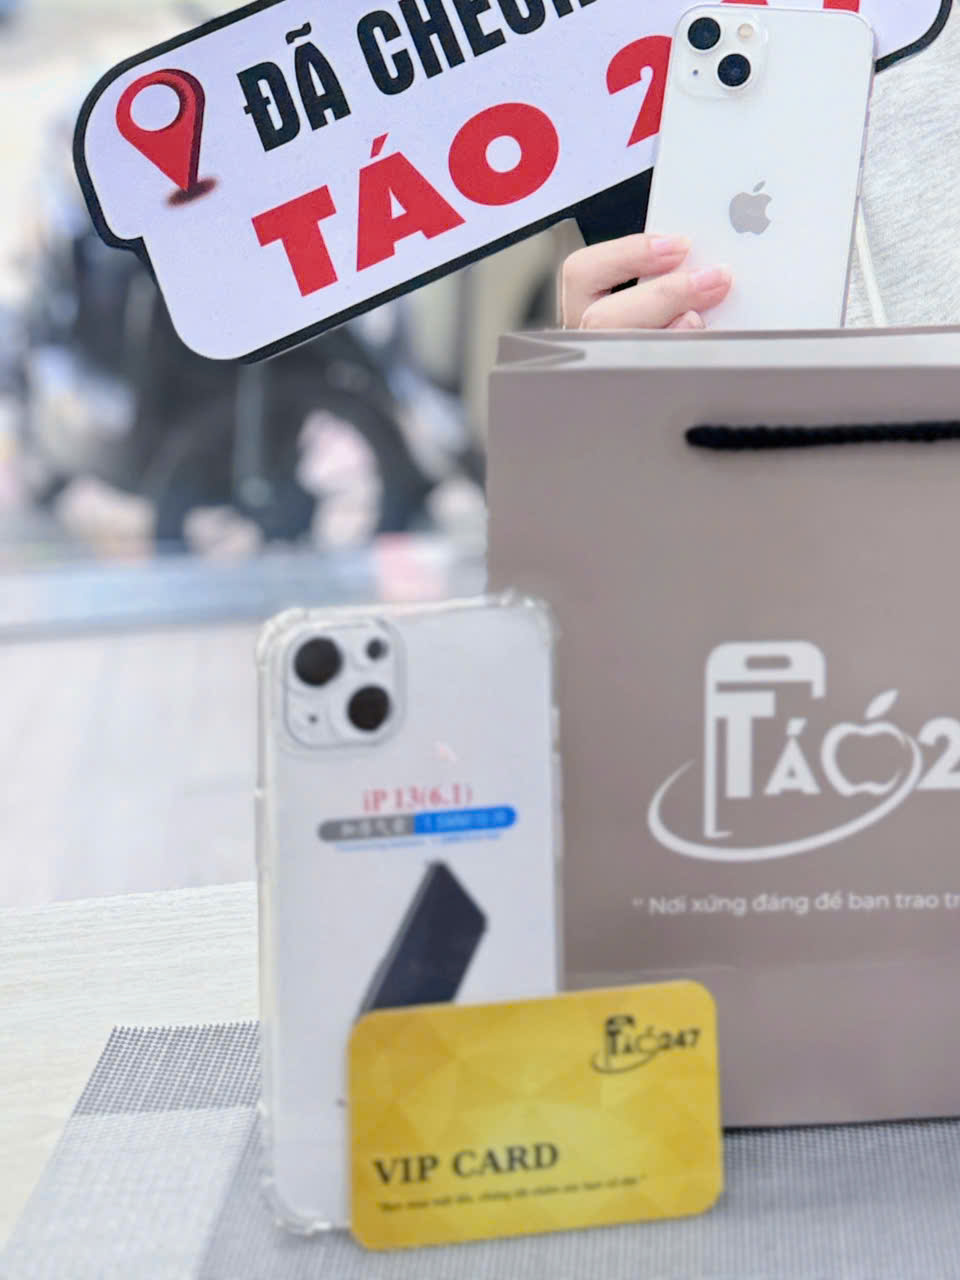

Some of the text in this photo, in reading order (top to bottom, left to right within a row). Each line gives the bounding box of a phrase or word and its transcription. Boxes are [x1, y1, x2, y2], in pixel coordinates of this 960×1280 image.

[236, 22, 351, 152] ĐÃ
[252, 103, 560, 297] TÁO
[894, 891, 939, 910] trao
[372, 1141, 560, 1186] VIP CARD
